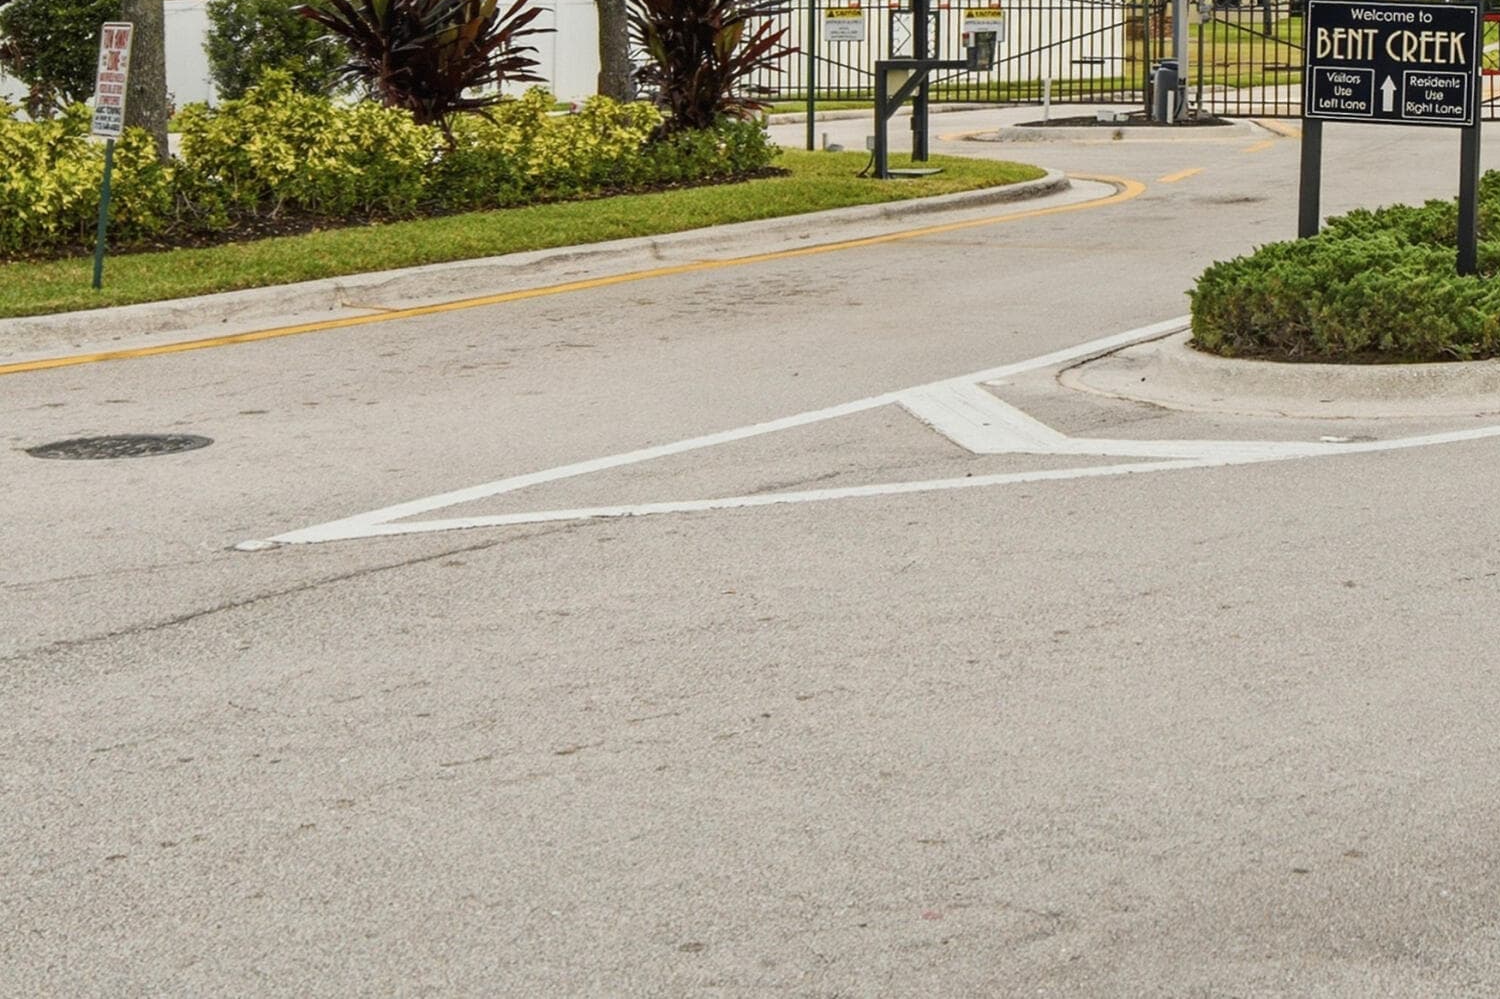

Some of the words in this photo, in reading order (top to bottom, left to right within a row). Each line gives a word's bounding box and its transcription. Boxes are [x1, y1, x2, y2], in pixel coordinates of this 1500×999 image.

[1351, 8, 1415, 23] Welcome
[1419, 10, 1433, 24] to
[1316, 27, 1379, 61] BENT
[1385, 30, 1466, 65] CREEK
[1326, 71, 1362, 85] Visitors
[1409, 75, 1461, 88] Residents
[1334, 85, 1353, 97] Use
[1425, 89, 1444, 101] Use
[1319, 98, 1338, 109] Left
[1341, 99, 1367, 110] Lane
[1406, 101, 1433, 114] Right
[1435, 103, 1462, 114] Lane
